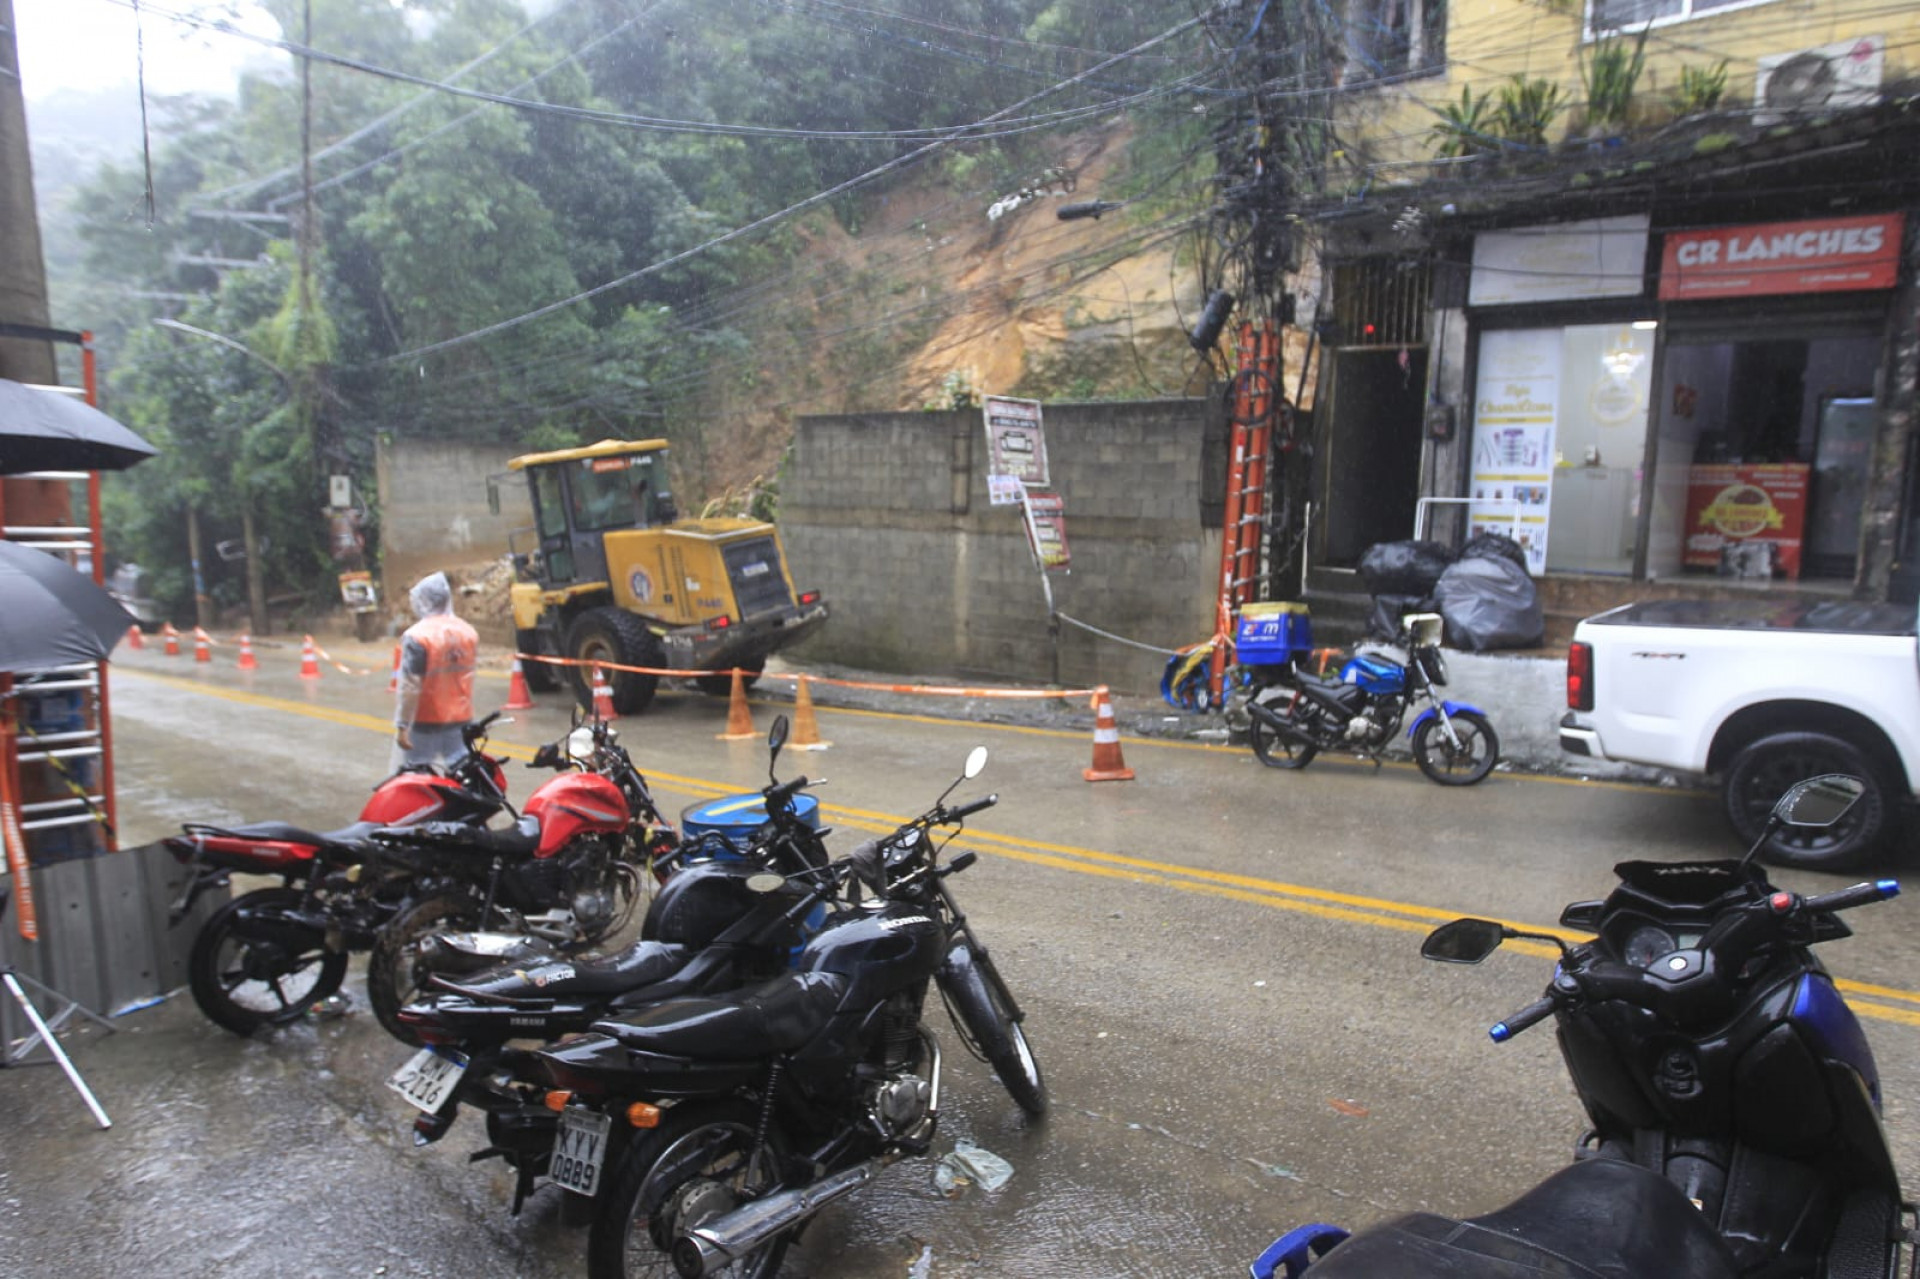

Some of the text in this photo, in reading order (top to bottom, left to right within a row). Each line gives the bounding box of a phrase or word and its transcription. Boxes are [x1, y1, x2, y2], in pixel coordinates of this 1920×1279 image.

[1677, 225, 1885, 267] CR LANCHES
[878, 916, 932, 930] HONDA
[509, 1017, 546, 1026] YAMAHA
[552, 1153, 595, 1190] 0889
